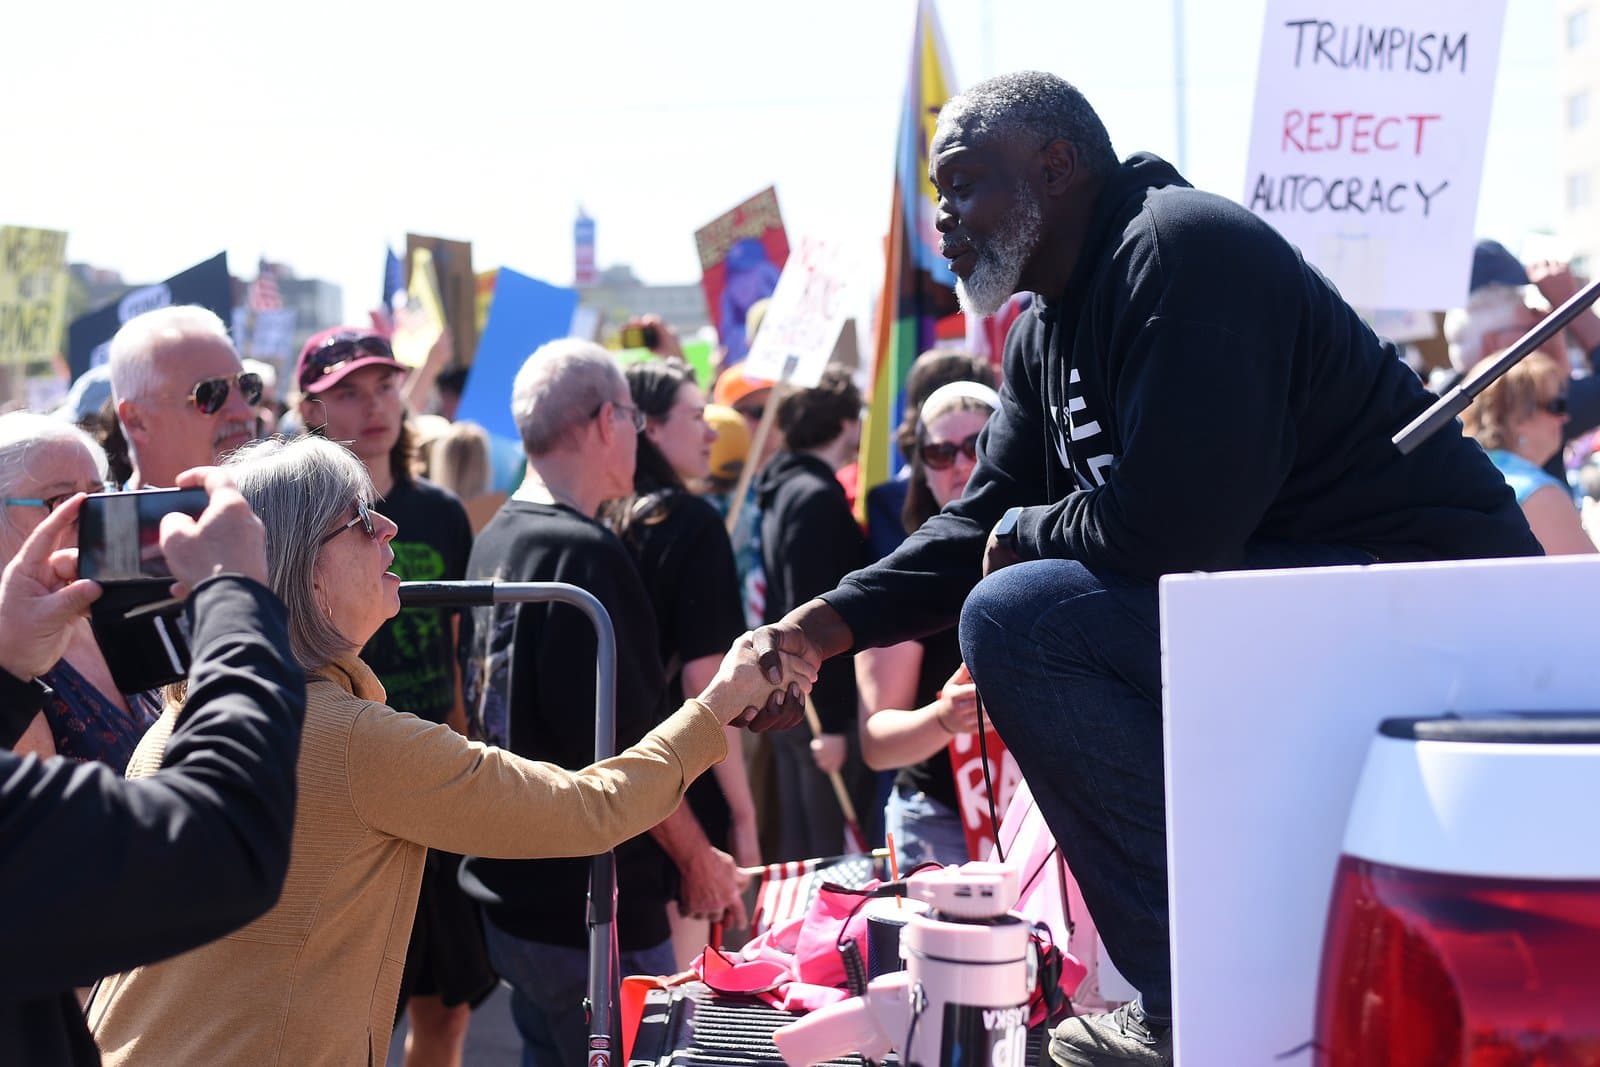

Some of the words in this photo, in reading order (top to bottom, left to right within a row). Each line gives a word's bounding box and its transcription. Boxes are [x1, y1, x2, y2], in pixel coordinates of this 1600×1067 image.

[1285, 20, 1468, 74] TRUMPISM
[1281, 110, 1442, 155] REJECT
[1249, 172, 1449, 217] AUTOCRACY
